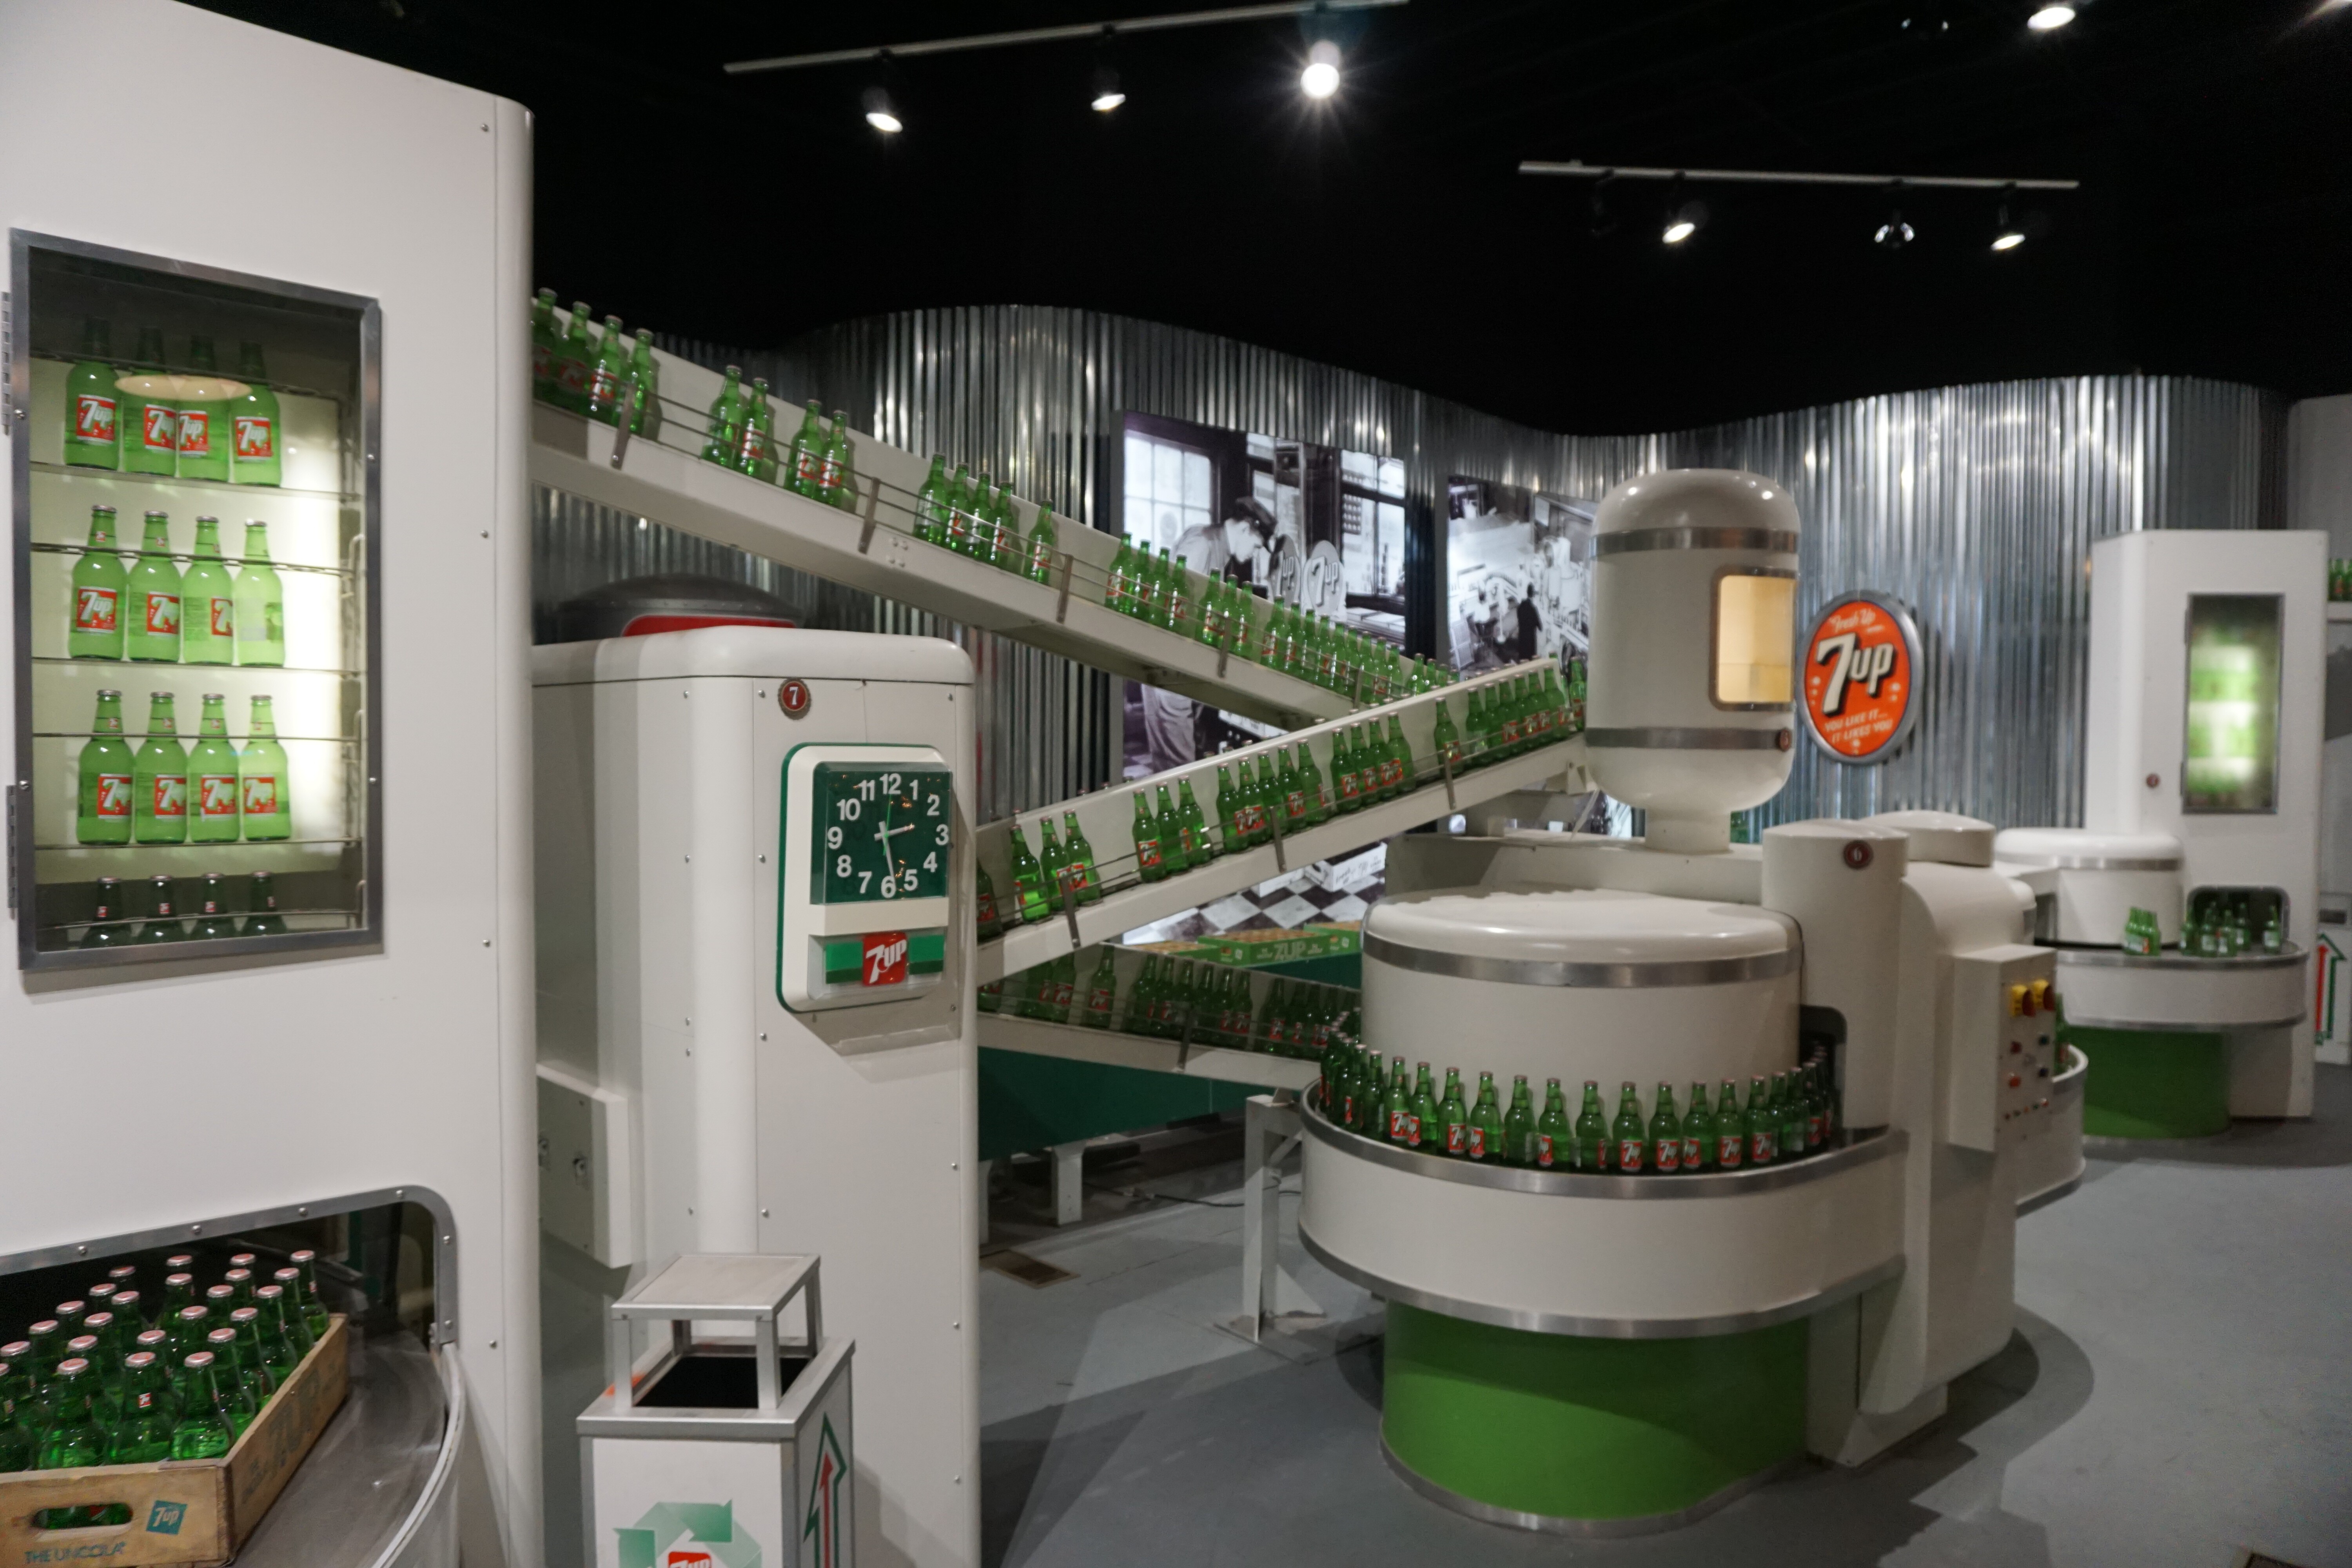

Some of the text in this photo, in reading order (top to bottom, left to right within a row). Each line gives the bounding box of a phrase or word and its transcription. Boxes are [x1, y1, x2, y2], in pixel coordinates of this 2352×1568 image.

[789, 686, 799, 705] 7
[1825, 720, 1842, 732] YOU
[1846, 712, 1866, 726] LIKE
[1832, 718, 1893, 743] IT LIKES YOU
[859, 780, 875, 800] 11
[880, 773, 901, 794] 12
[910, 780, 918, 800] 1
[837, 798, 861, 820] 10
[927, 795, 940, 816] 2
[828, 826, 843, 849] 9
[936, 824, 949, 846] 3
[837, 855, 852, 877] 8
[923, 852, 937, 872] 4
[858, 871, 873, 893] 7
[881, 876, 897, 898] 6
[905, 869, 918, 891] 5
